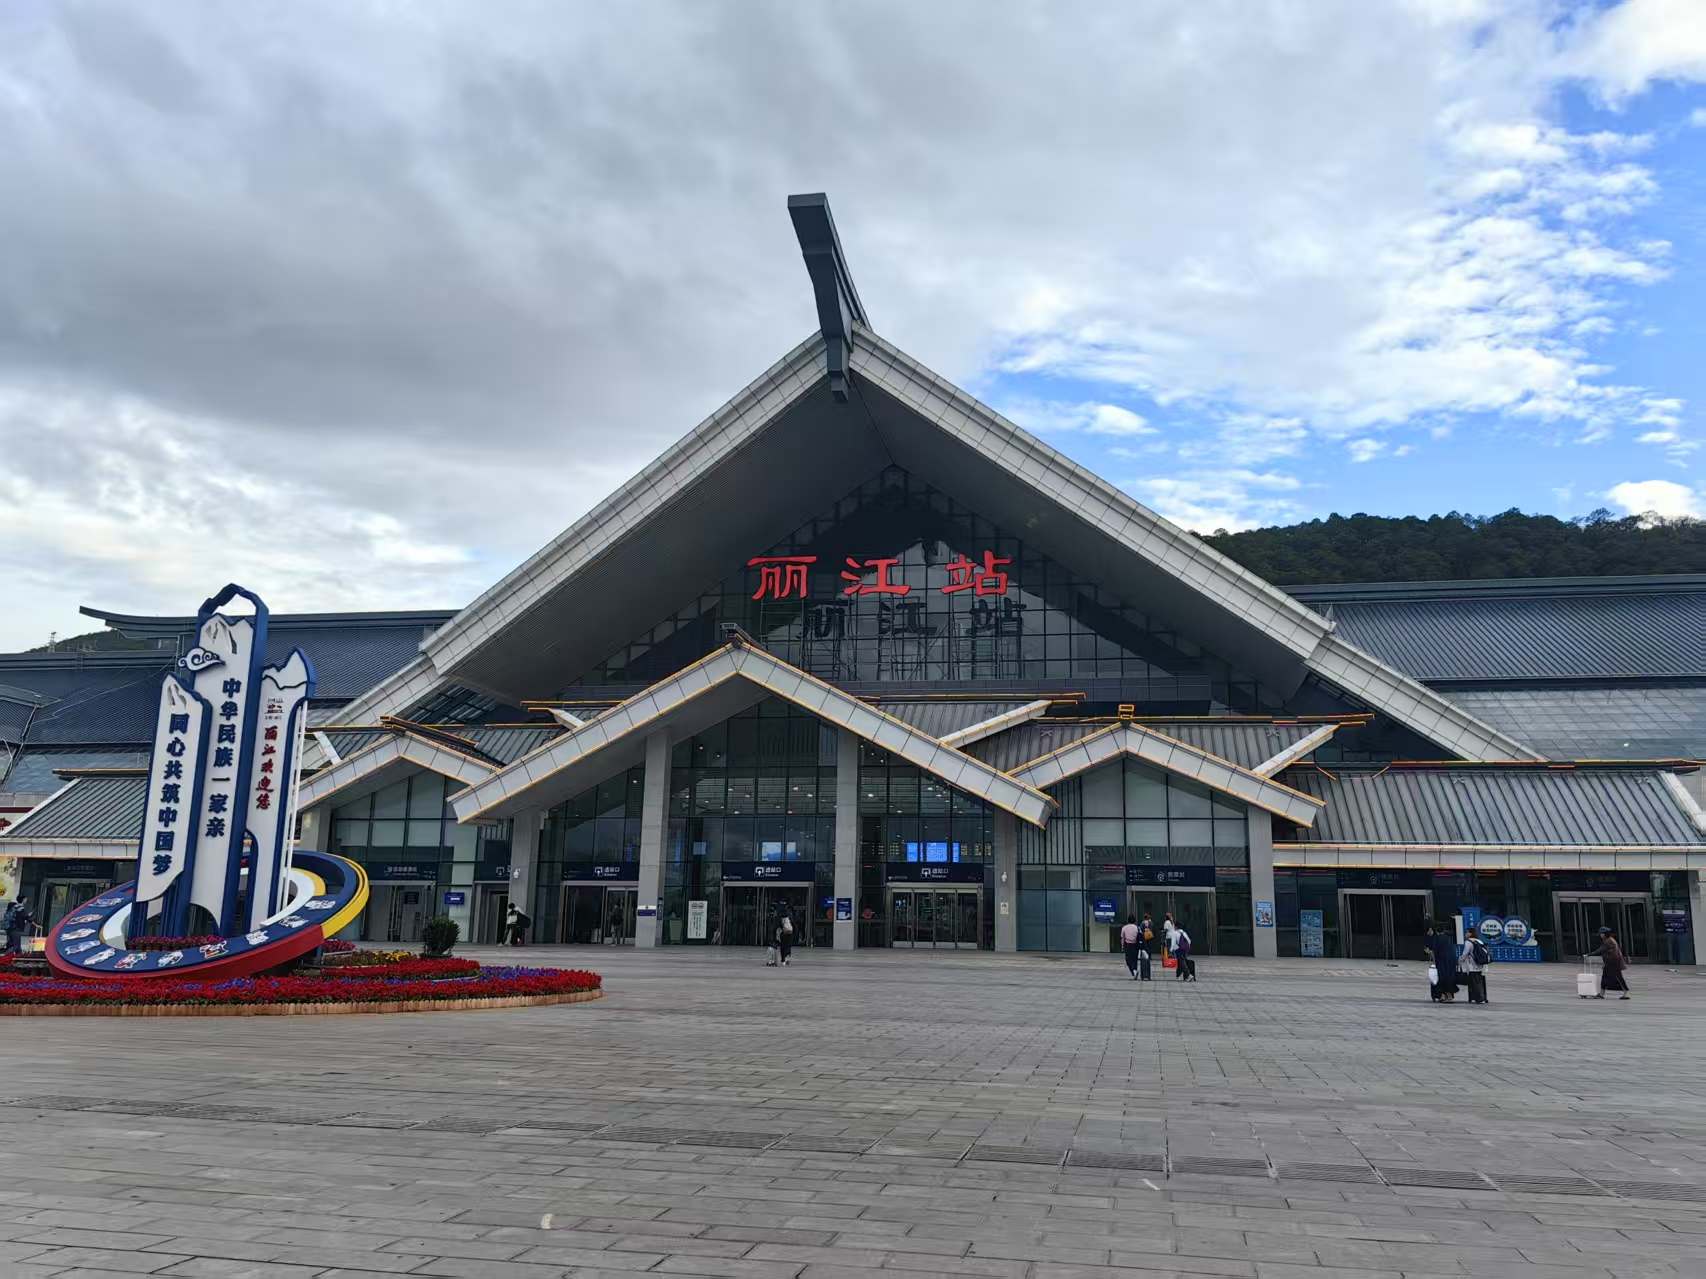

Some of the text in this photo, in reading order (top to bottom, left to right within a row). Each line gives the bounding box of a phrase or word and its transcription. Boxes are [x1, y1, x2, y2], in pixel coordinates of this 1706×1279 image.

[747, 550, 1013, 600] 丽江站
[152, 713, 190, 876] 同心共筑中国梦
[205, 678, 242, 838] 中华民族一家亲
[256, 725, 279, 810] 丽江欢迎您
